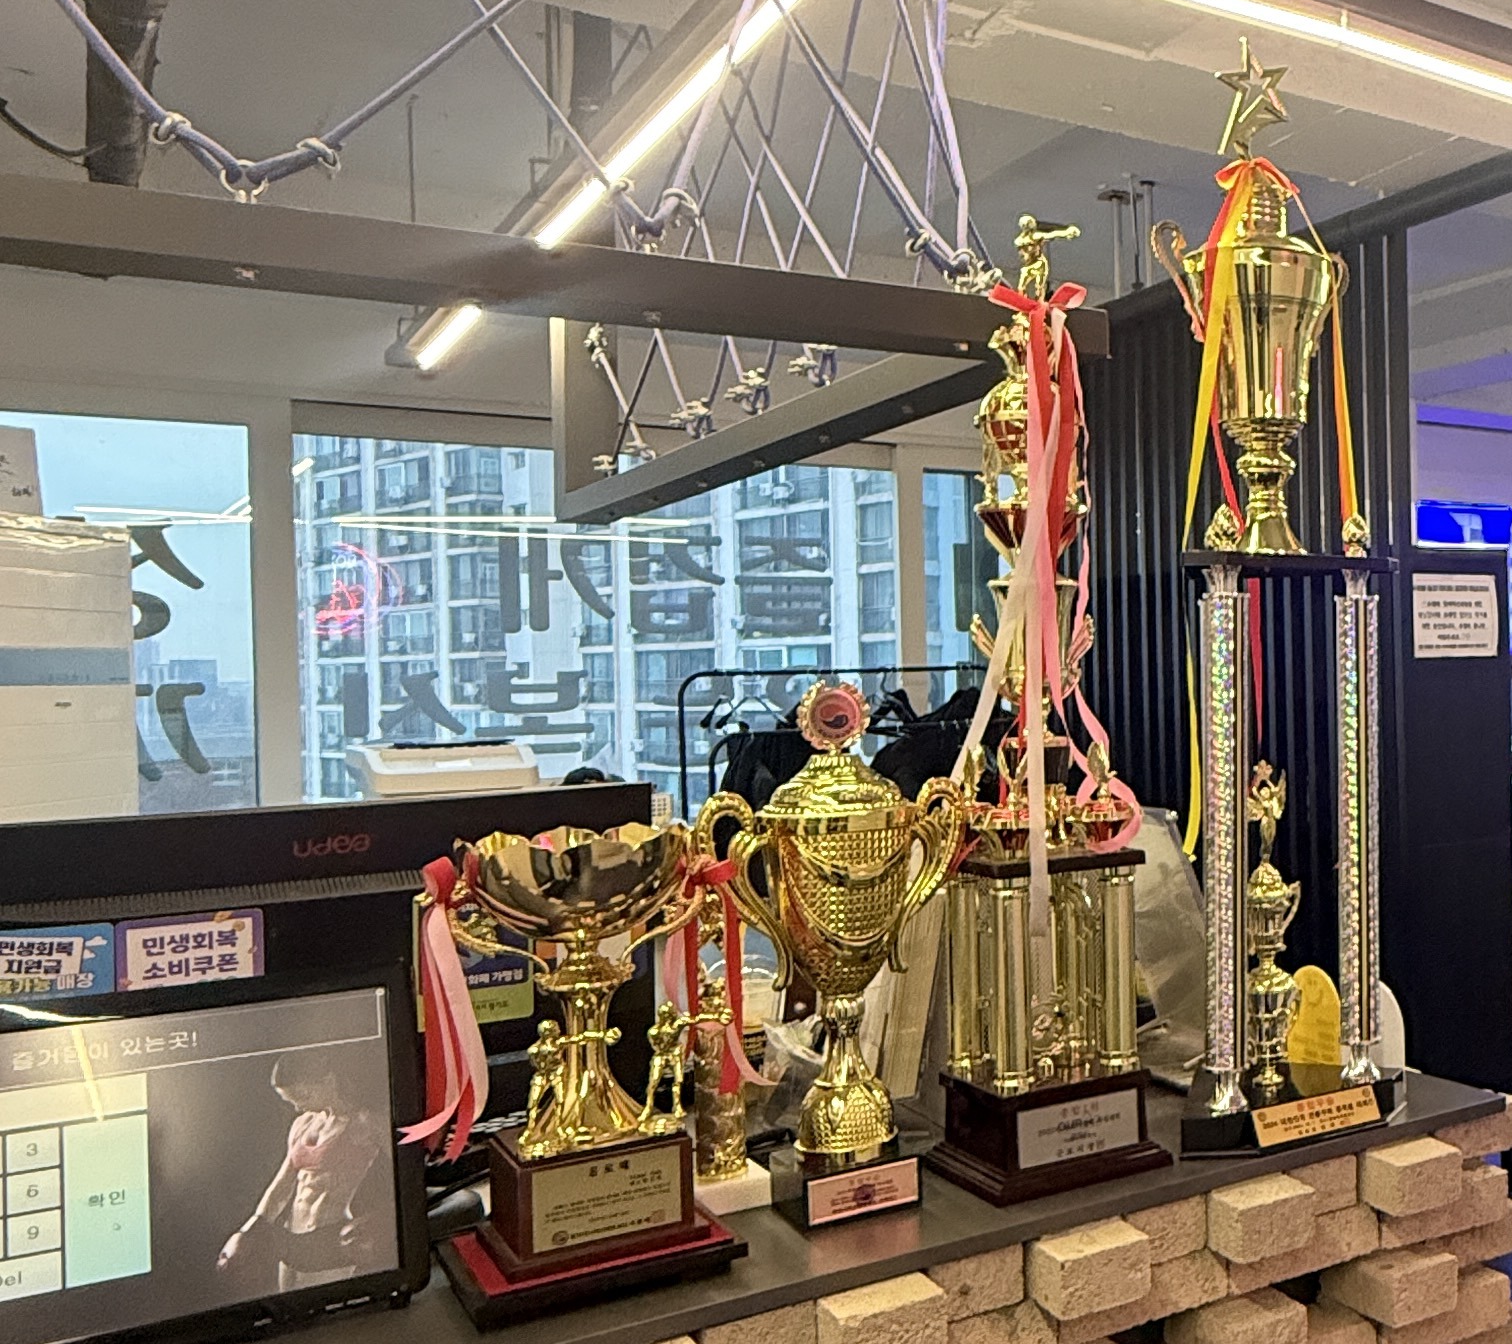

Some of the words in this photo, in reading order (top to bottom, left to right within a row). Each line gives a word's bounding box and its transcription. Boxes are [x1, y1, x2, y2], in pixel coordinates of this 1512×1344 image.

[0, 940, 74, 957] 민생회복
[142, 928, 239, 958] 민생회복
[4, 958, 63, 975] 지원금
[142, 952, 239, 981] 소비쿠폰
[56, 971, 94, 991] 매장
[120, 1031, 199, 1057] 있는곳!
[26, 1143, 38, 1157] 3
[26, 1185, 39, 1198] 6
[88, 1189, 126, 1208] 확인
[27, 1226, 40, 1241] 9
